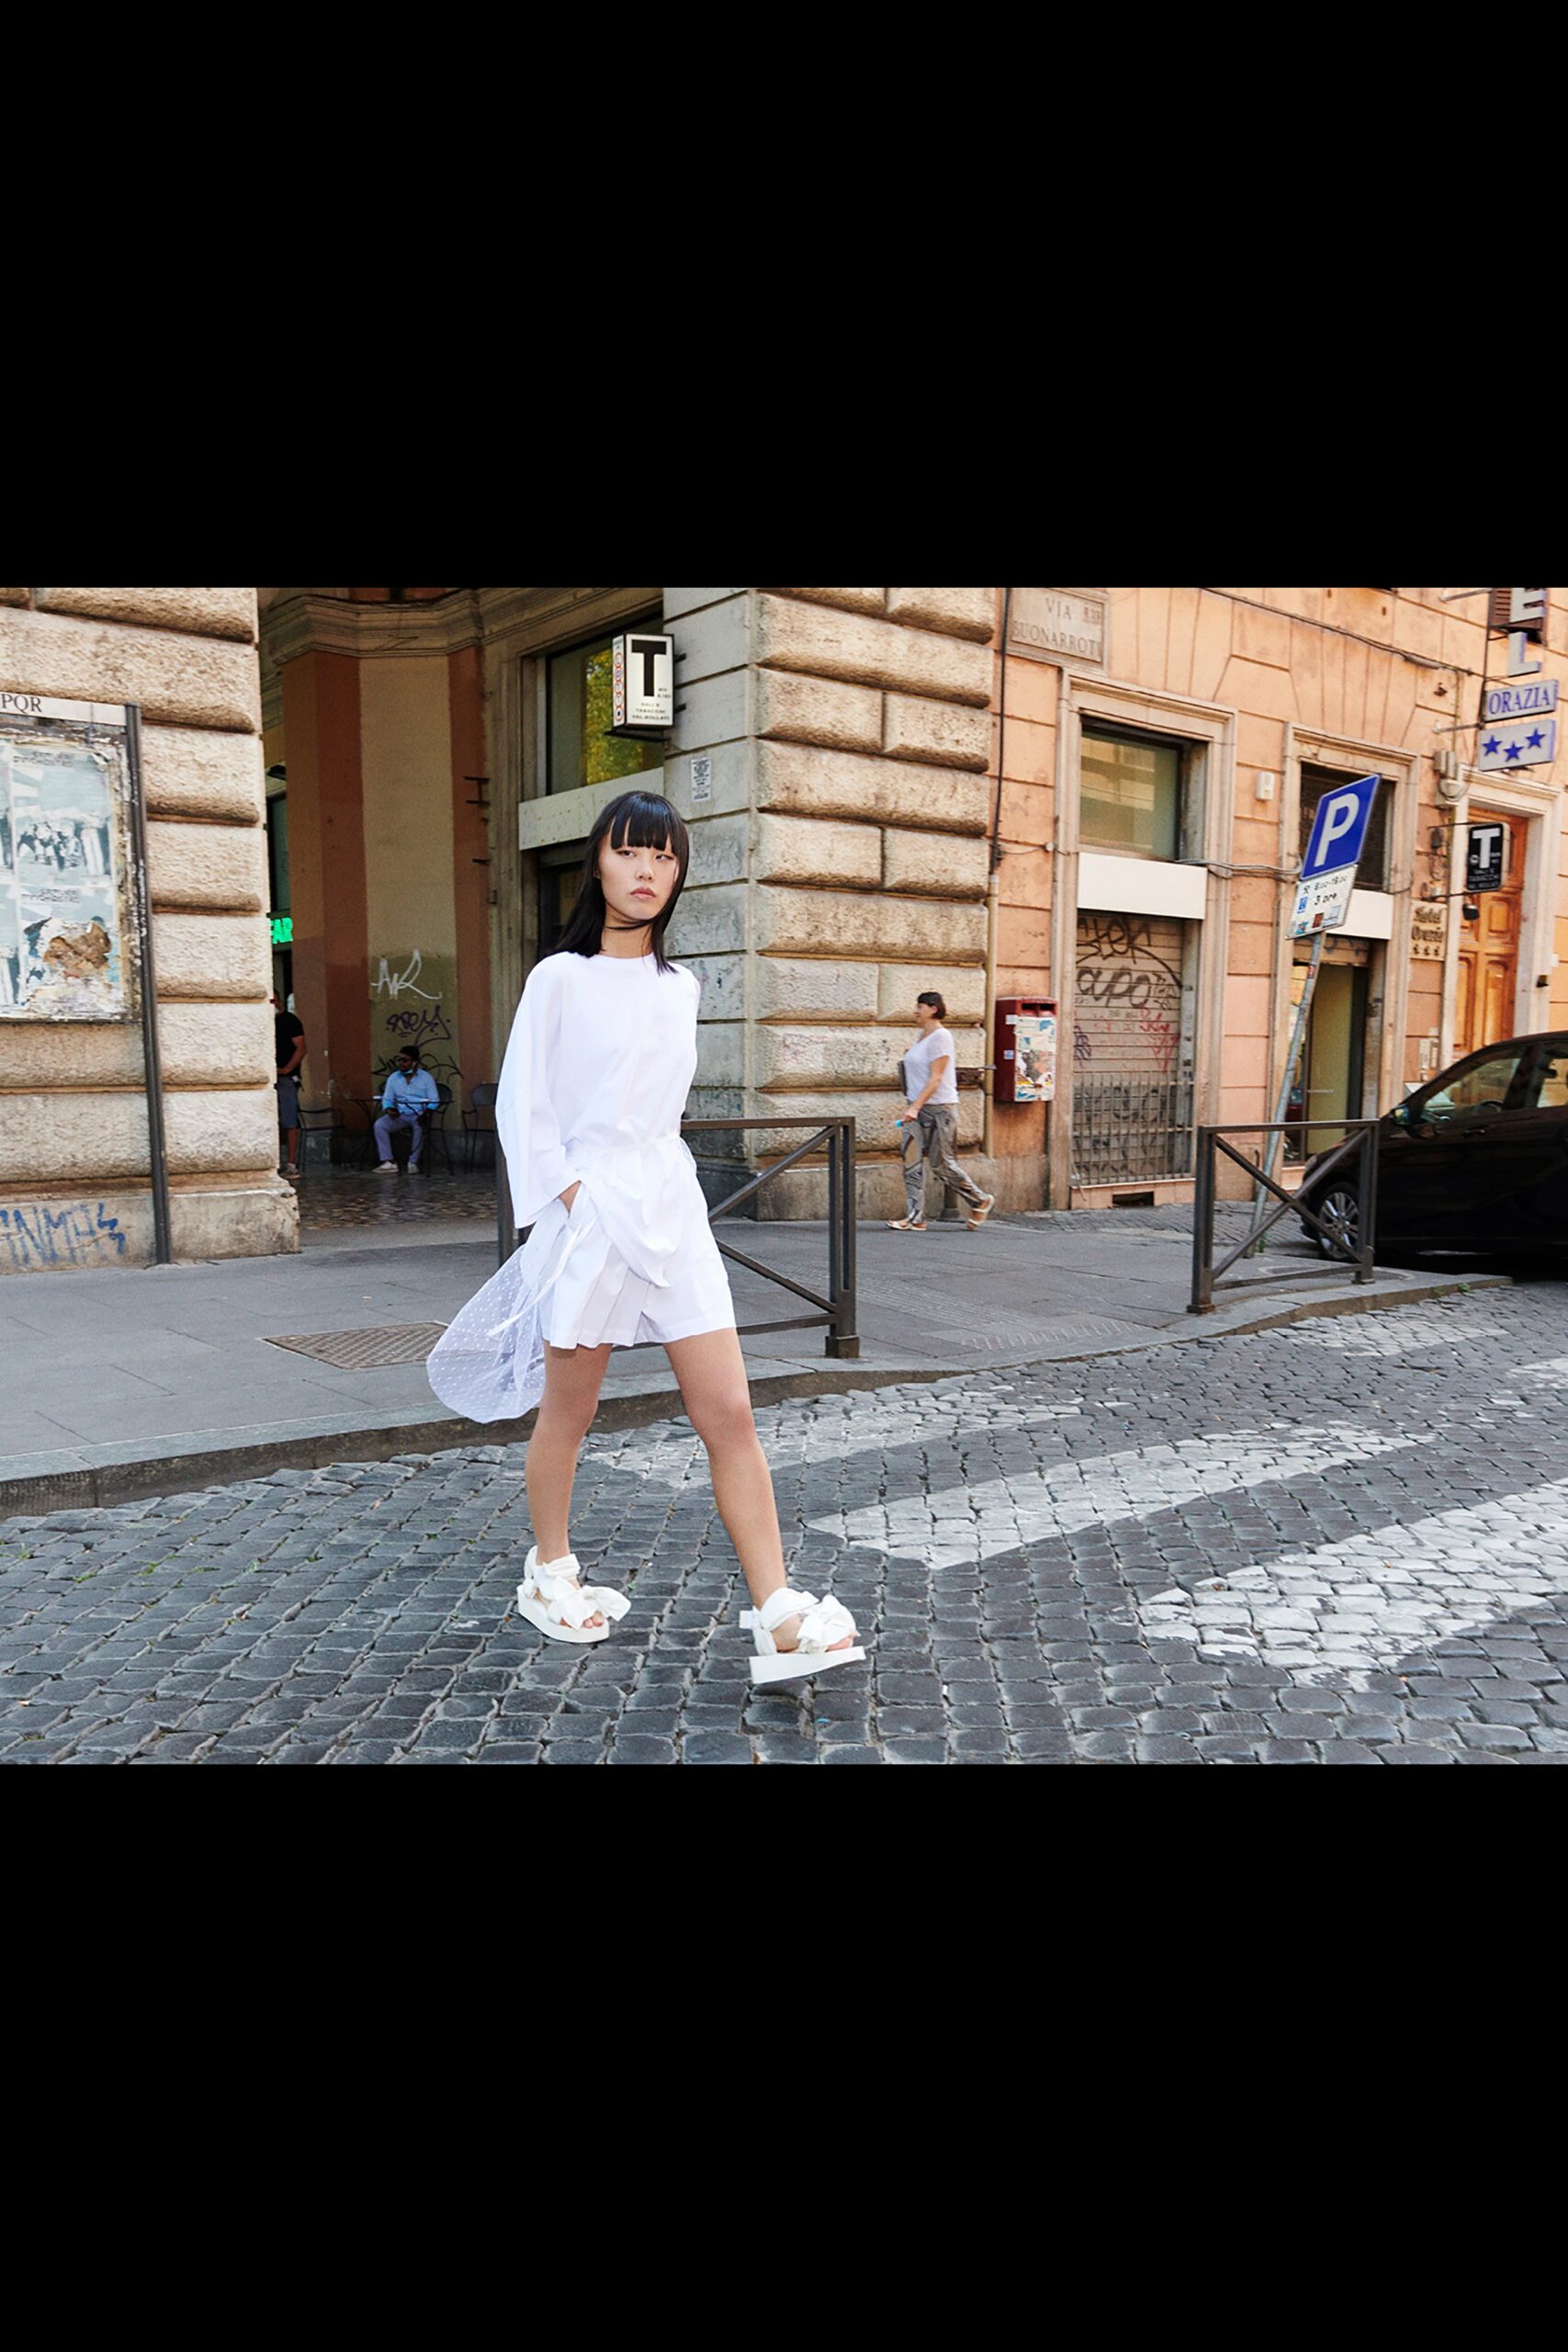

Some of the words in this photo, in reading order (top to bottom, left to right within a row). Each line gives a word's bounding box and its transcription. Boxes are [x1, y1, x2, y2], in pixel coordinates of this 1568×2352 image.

[1045, 597, 1072, 621] VIA
[631, 639, 667, 696] T
[0, 693, 42, 714] PQR
[1488, 686, 1551, 715] ORAZIA
[1314, 793, 1359, 867] P
[1472, 828, 1501, 869] T
